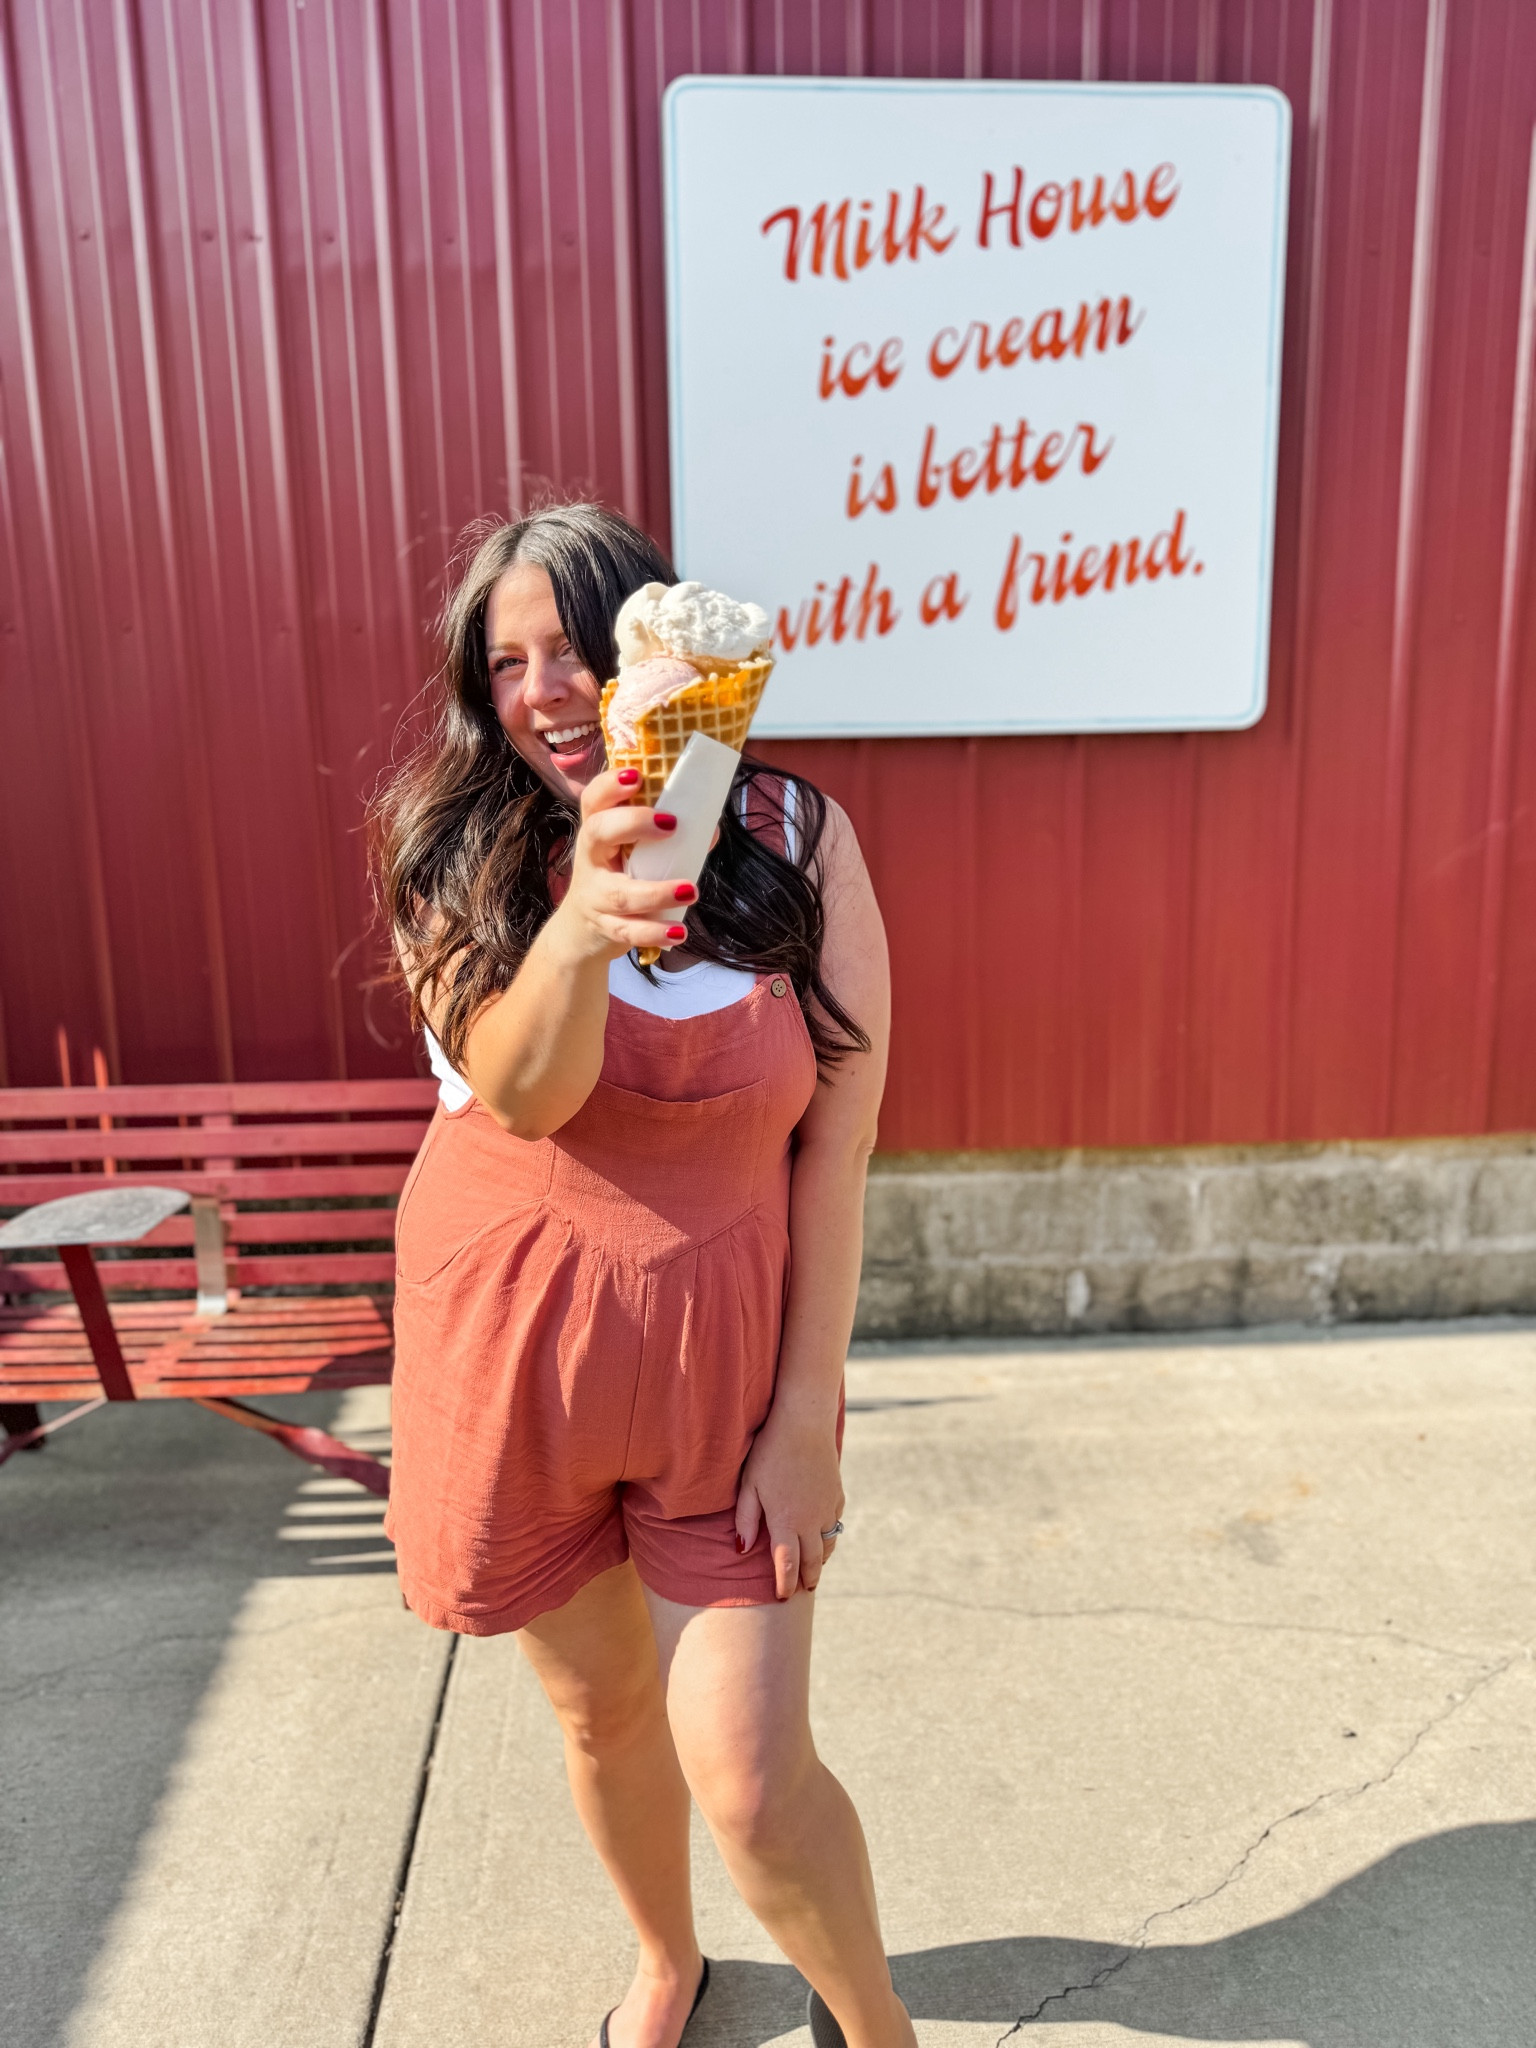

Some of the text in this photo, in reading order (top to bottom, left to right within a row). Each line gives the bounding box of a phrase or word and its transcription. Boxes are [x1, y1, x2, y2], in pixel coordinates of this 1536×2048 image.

[761, 162, 1182, 282] Milk House
[818, 294, 1146, 400] ice cream
[846, 418, 1115, 519] is better
[918, 571, 968, 627] a
[993, 509, 1206, 633] friend.
